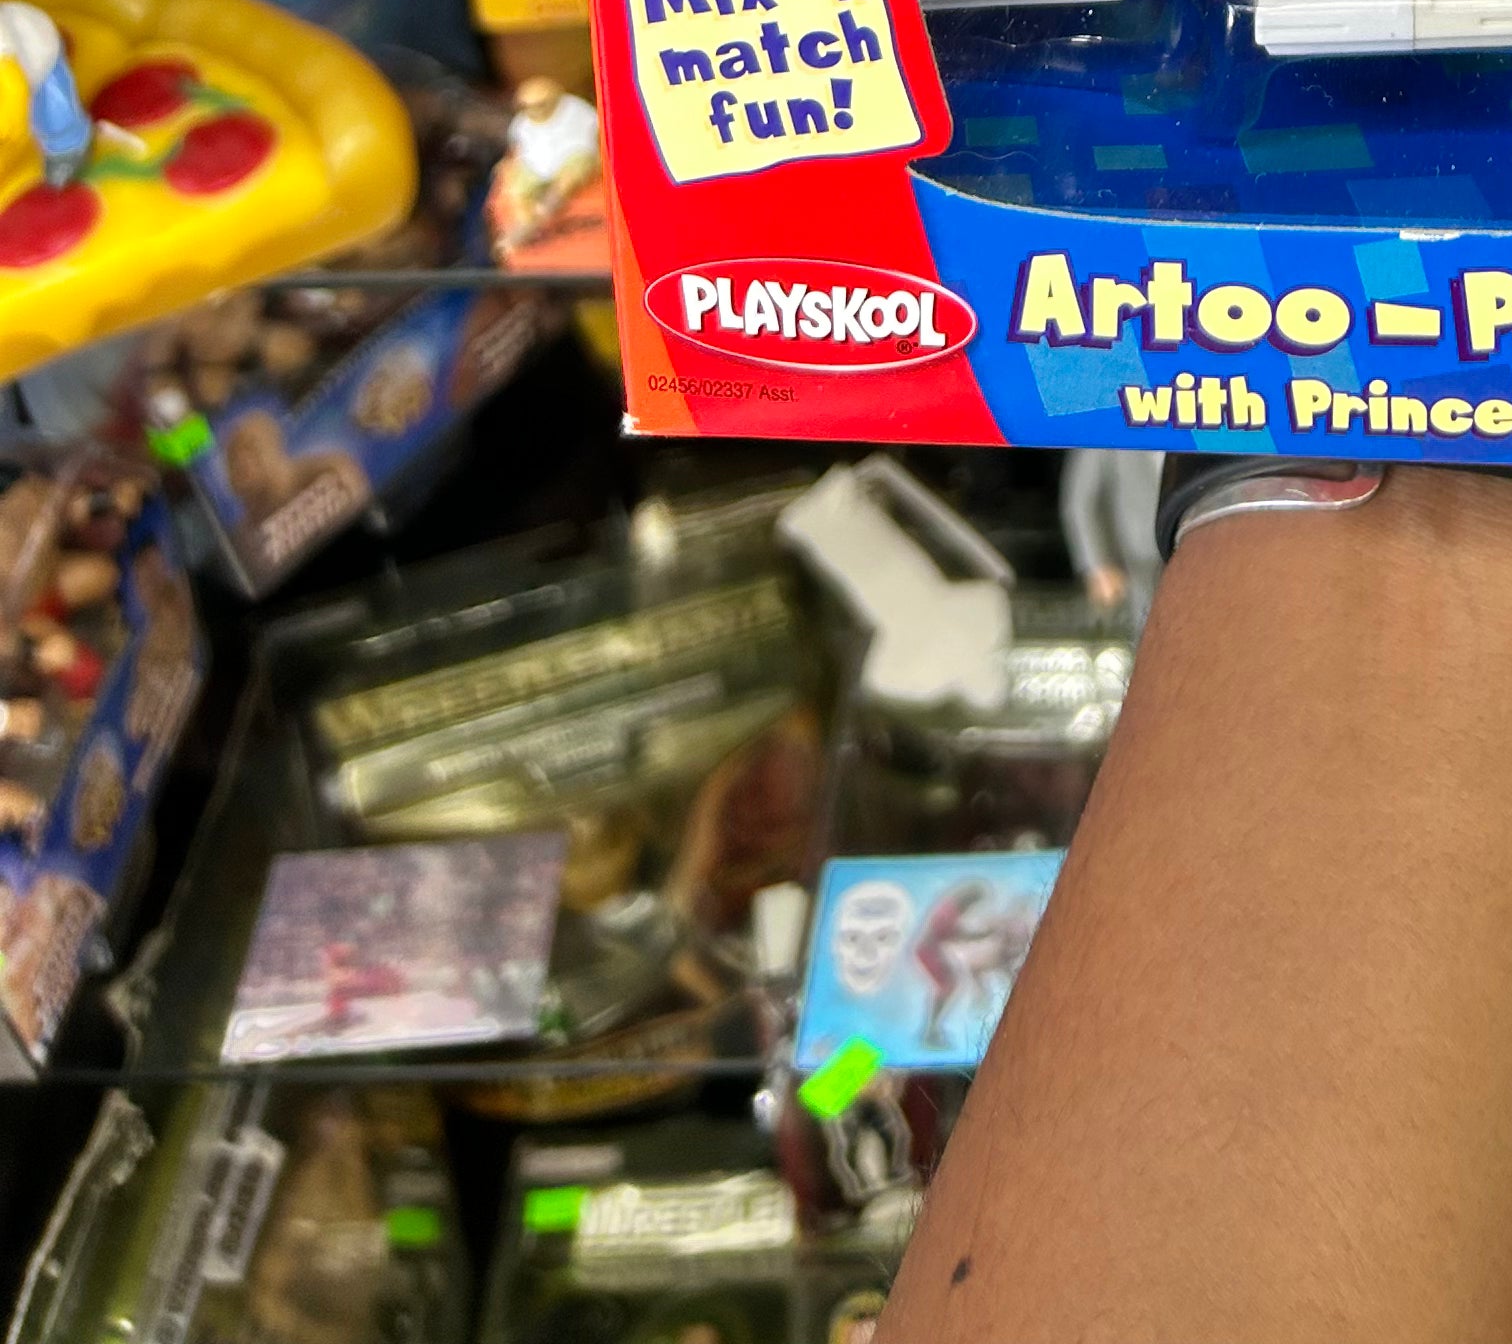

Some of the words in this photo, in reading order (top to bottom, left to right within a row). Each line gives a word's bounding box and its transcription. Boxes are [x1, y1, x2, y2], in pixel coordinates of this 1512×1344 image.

[659, 9, 883, 86] match
[709, 78, 855, 144] fun!
[681, 273, 947, 347] PLAYSKOOL
[1012, 252, 1350, 352] Artoo
[758, 384, 800, 403] Asst.
[1122, 371, 1268, 429] with
